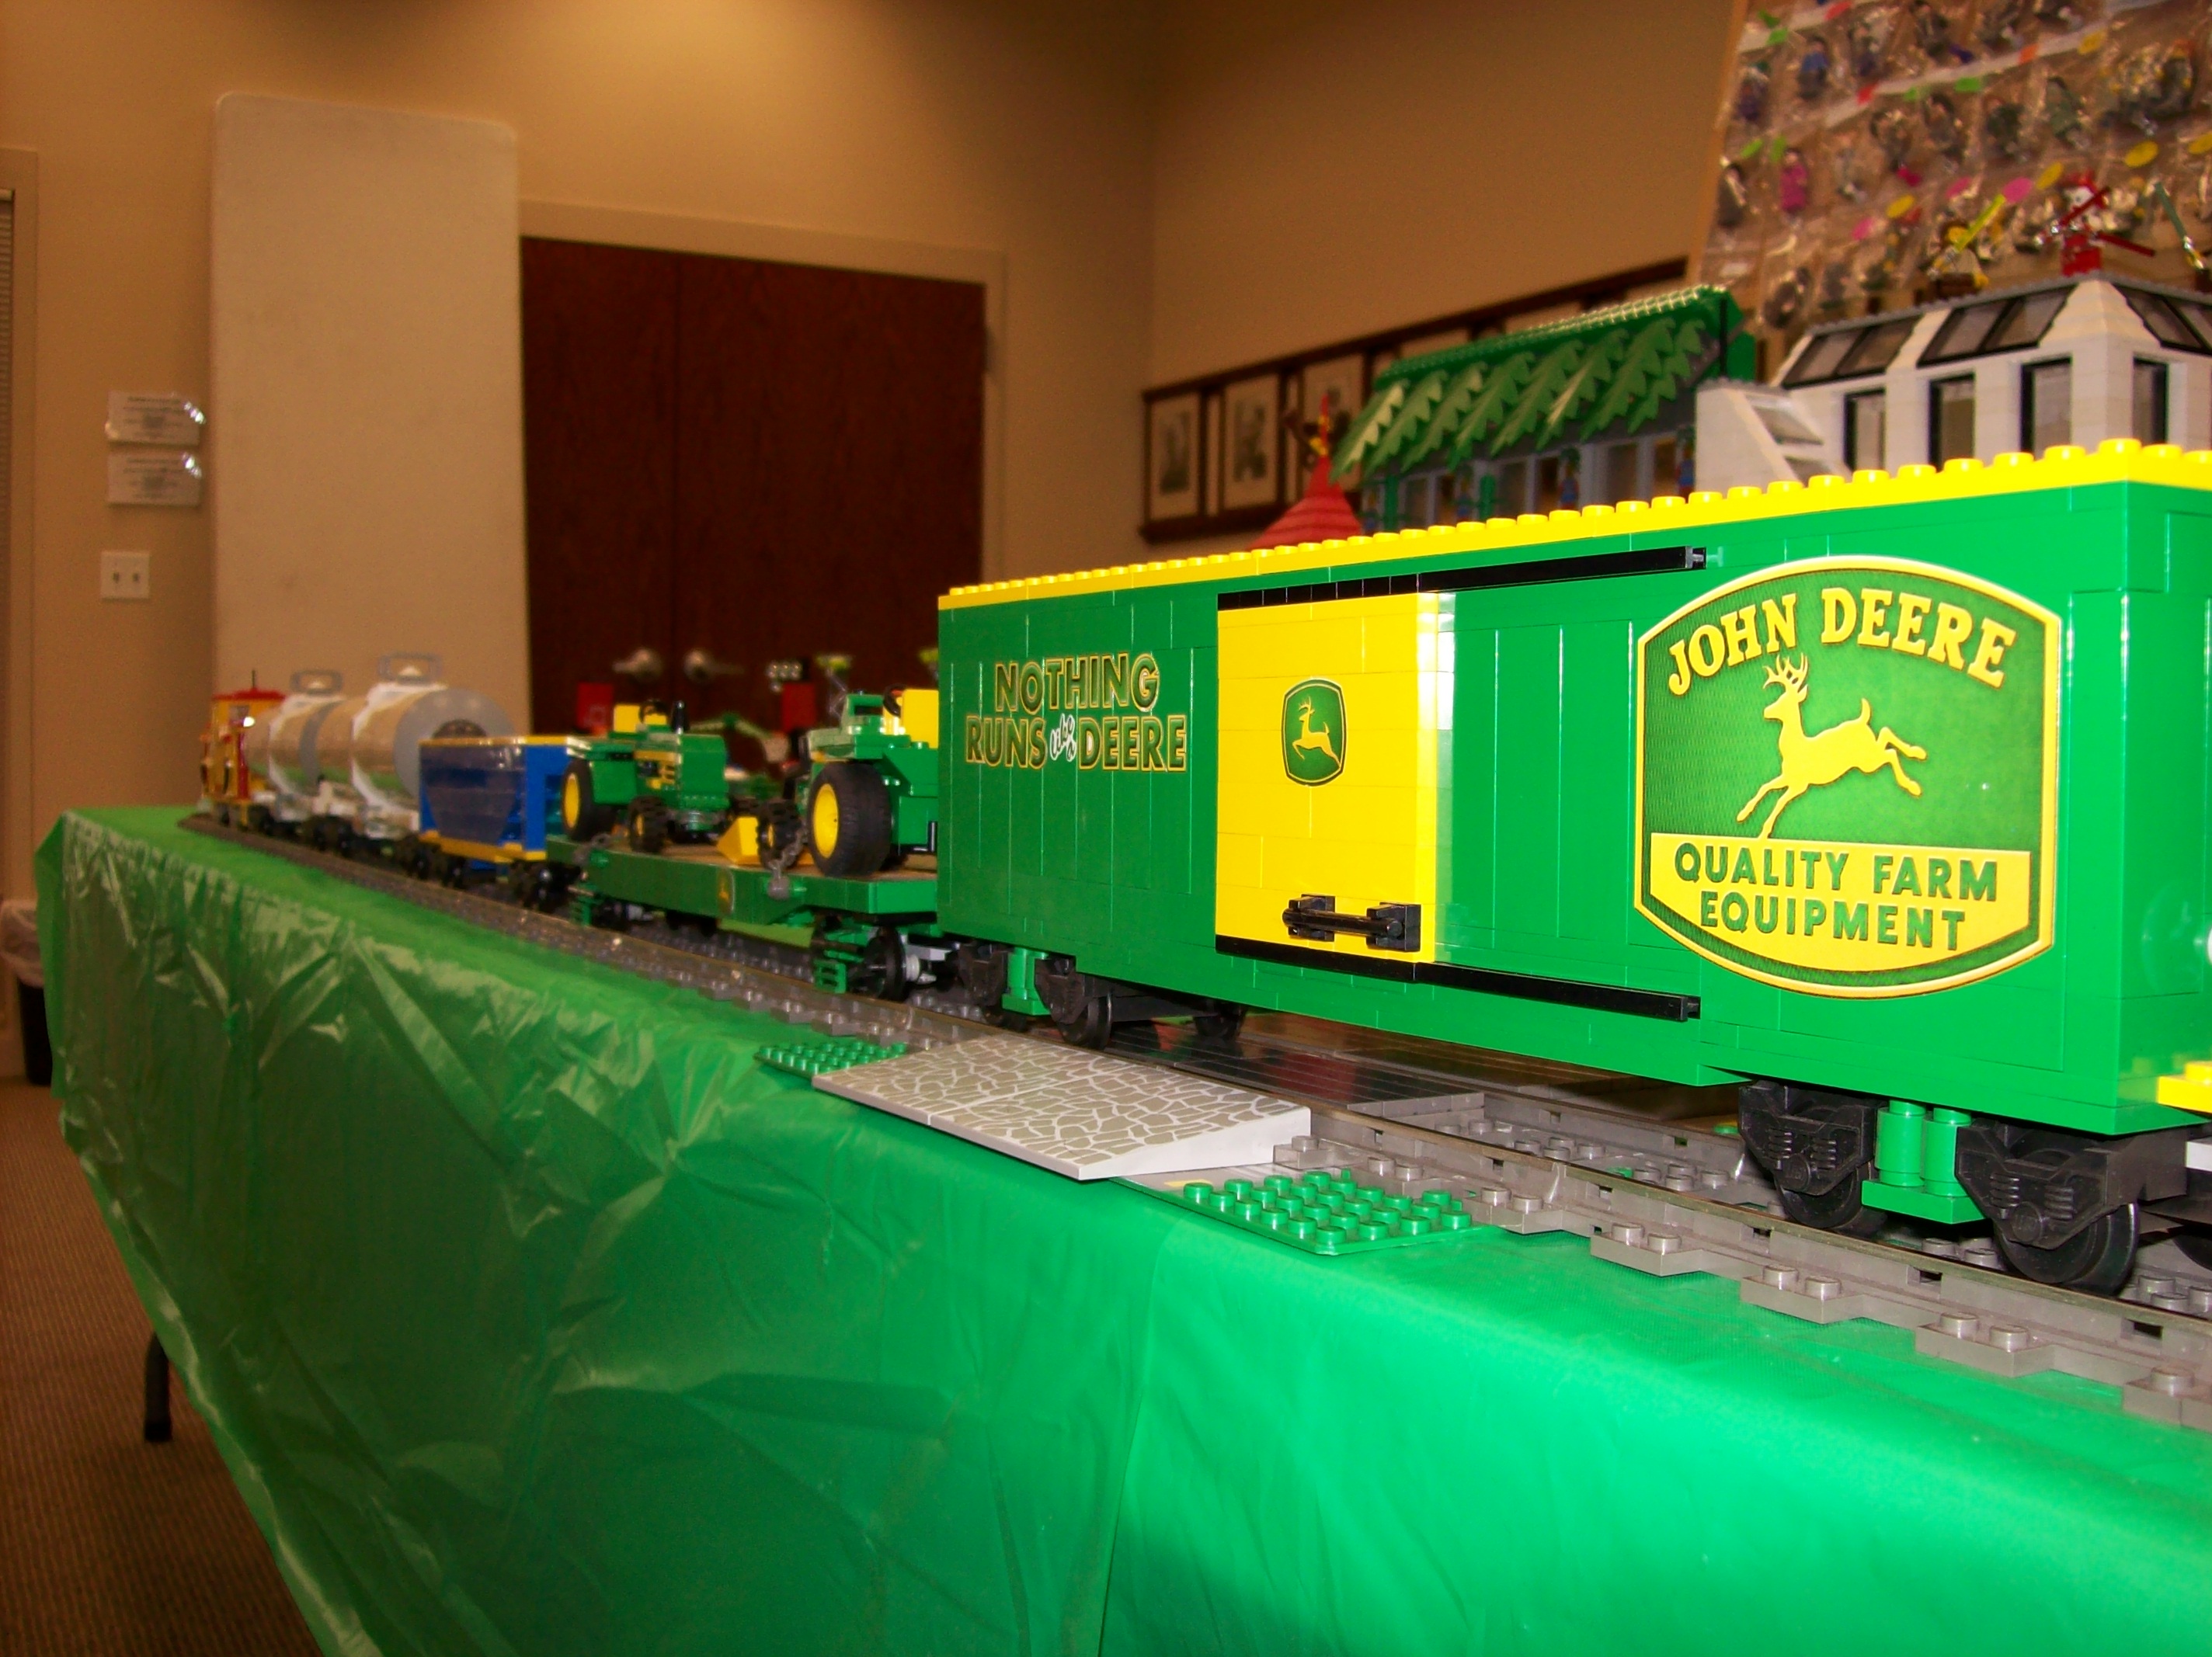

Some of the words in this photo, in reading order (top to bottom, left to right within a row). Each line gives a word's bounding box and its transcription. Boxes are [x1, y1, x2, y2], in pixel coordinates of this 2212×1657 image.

[1668, 593, 1796, 695] JOHN
[1821, 587, 2016, 688] DEERE
[995, 653, 1159, 714] NOTHING
[966, 715, 1047, 769] RUNS
[1079, 715, 1187, 771] DEERE
[1675, 843, 1849, 890] QUALITY
[1873, 855, 1997, 901] FARM
[1700, 891, 1965, 950] EQUIPMENT
